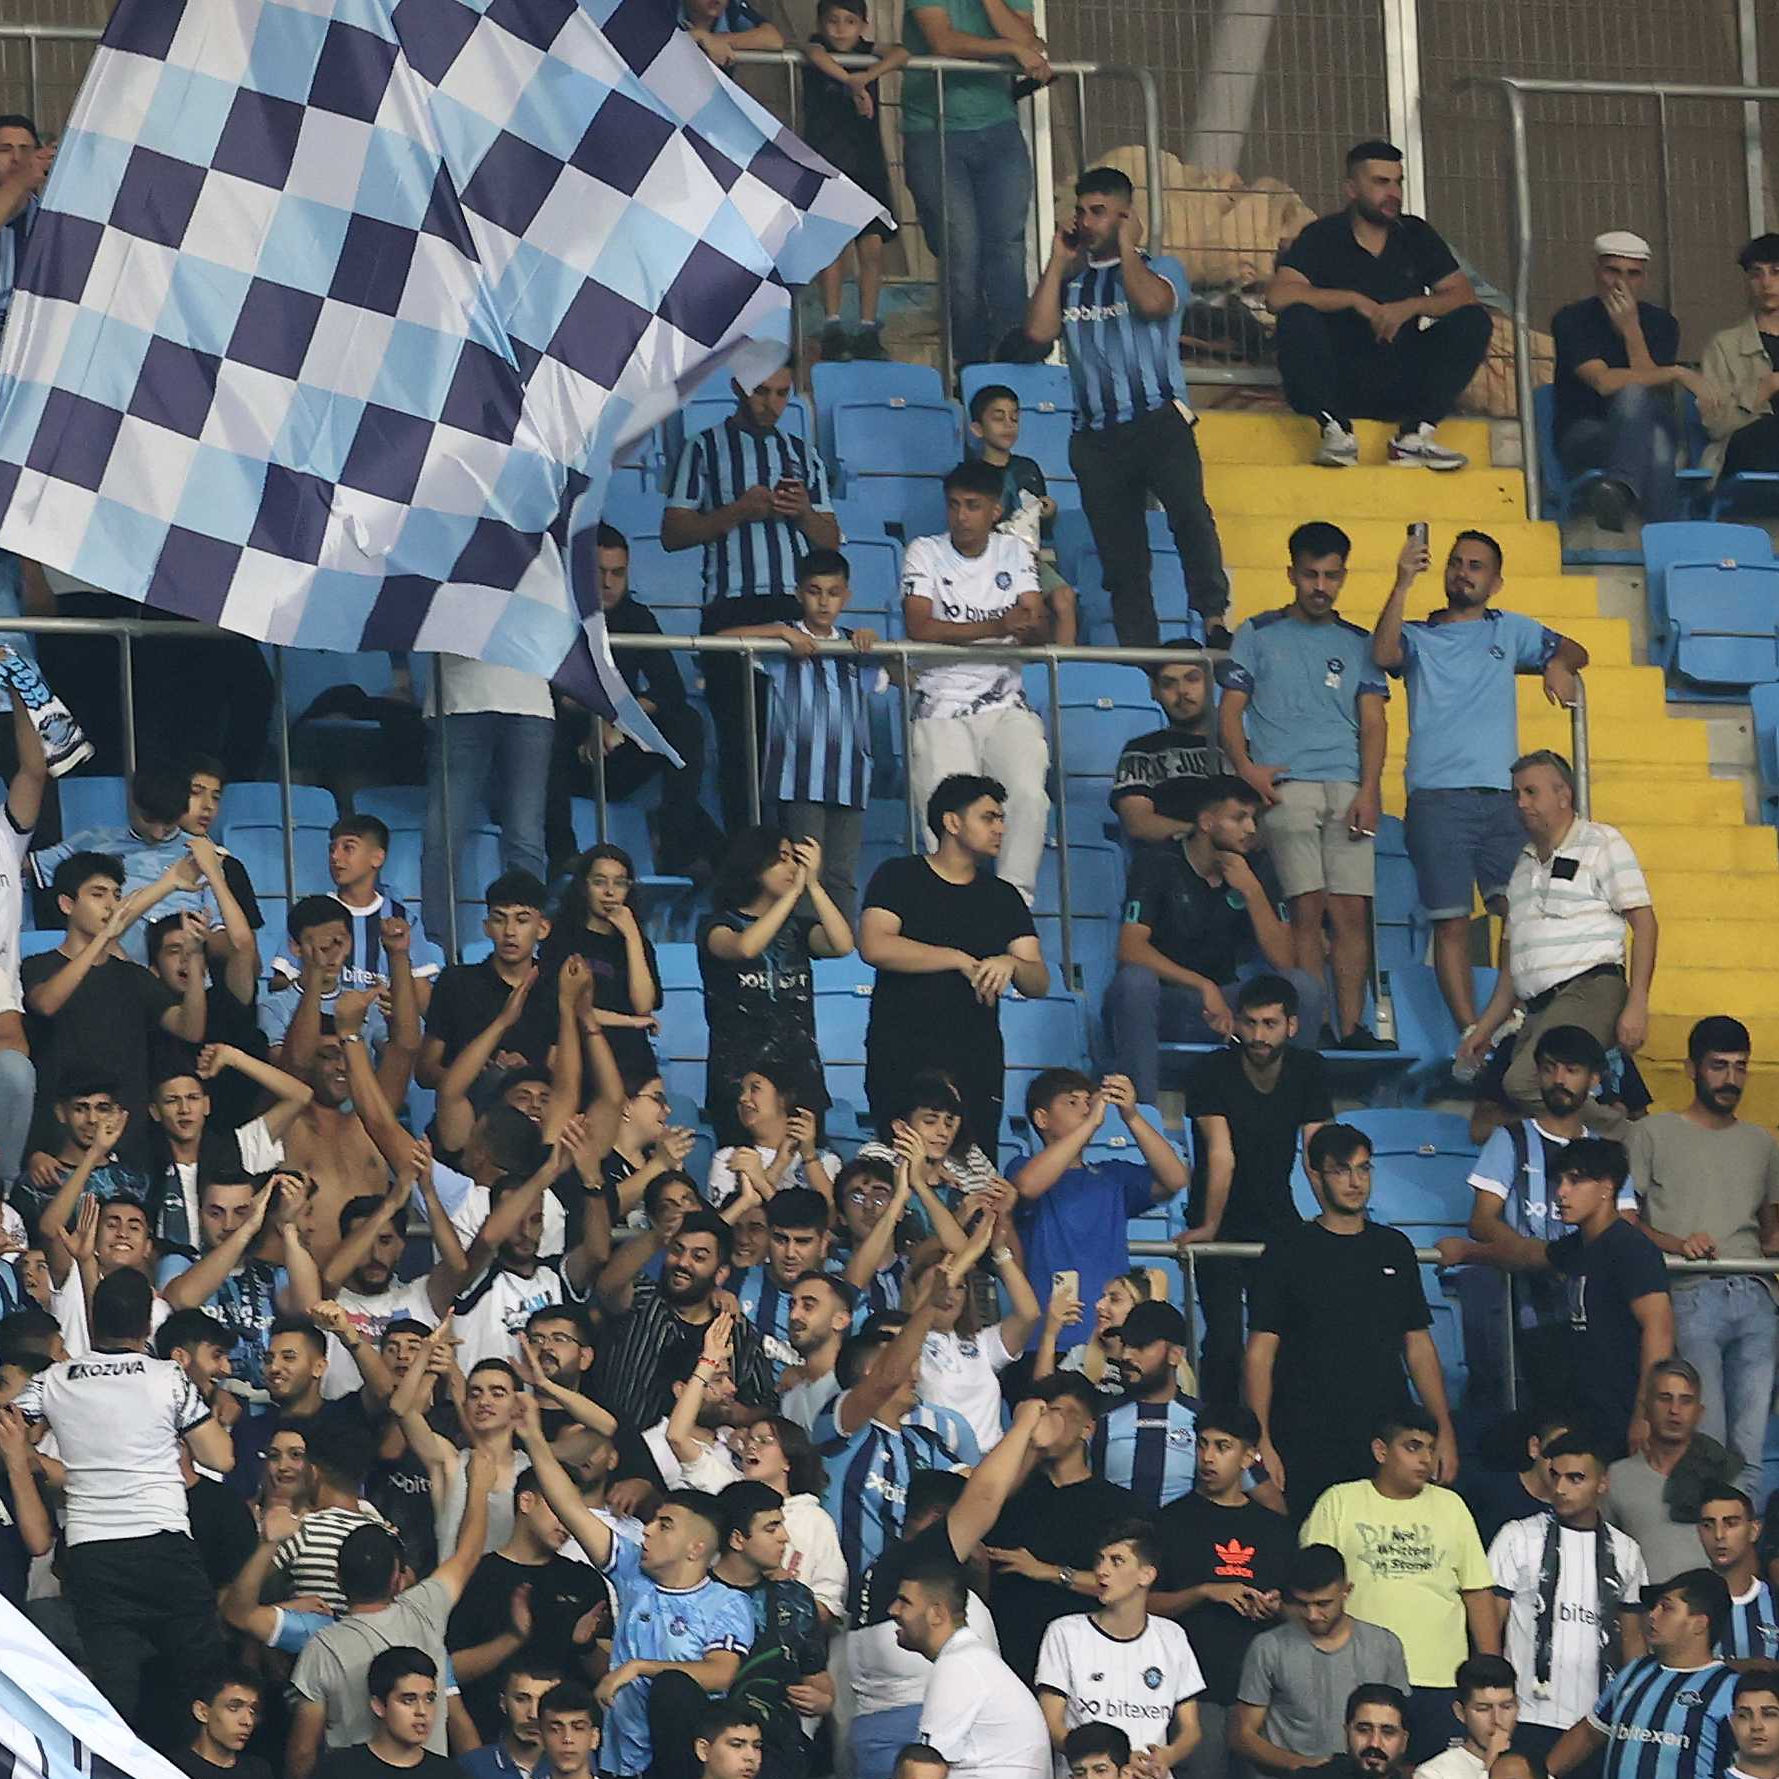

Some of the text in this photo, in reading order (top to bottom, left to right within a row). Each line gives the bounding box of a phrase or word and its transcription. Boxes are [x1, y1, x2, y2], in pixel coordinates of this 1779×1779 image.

[81, 1361, 147, 1378] KOZUVA
[1105, 1699, 1171, 1720] bitexen
[1616, 1721, 1691, 1749] bitexen
